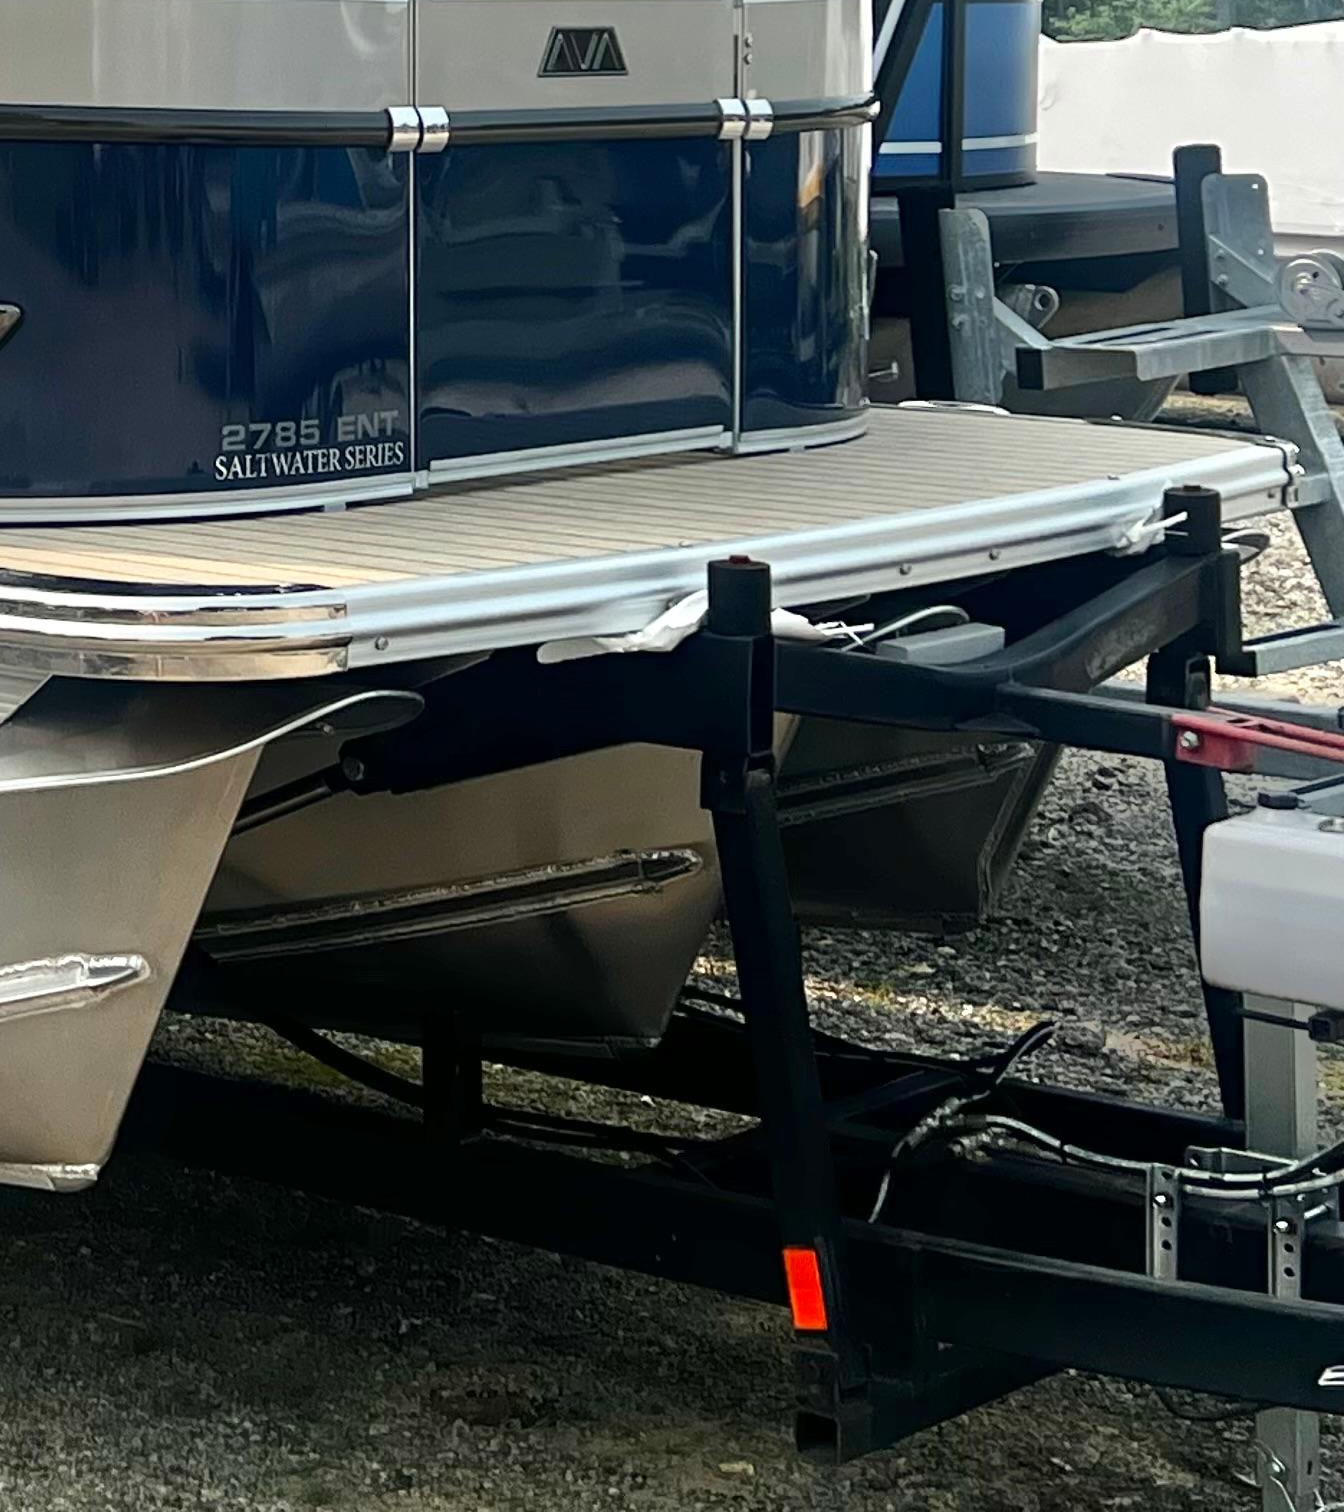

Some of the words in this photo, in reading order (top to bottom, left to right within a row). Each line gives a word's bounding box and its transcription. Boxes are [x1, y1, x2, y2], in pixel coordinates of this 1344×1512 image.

[544, 31, 623, 71] AVA
[221, 418, 320, 452] 2785
[336, 409, 399, 442] ENT
[344, 441, 405, 470] SERIES
